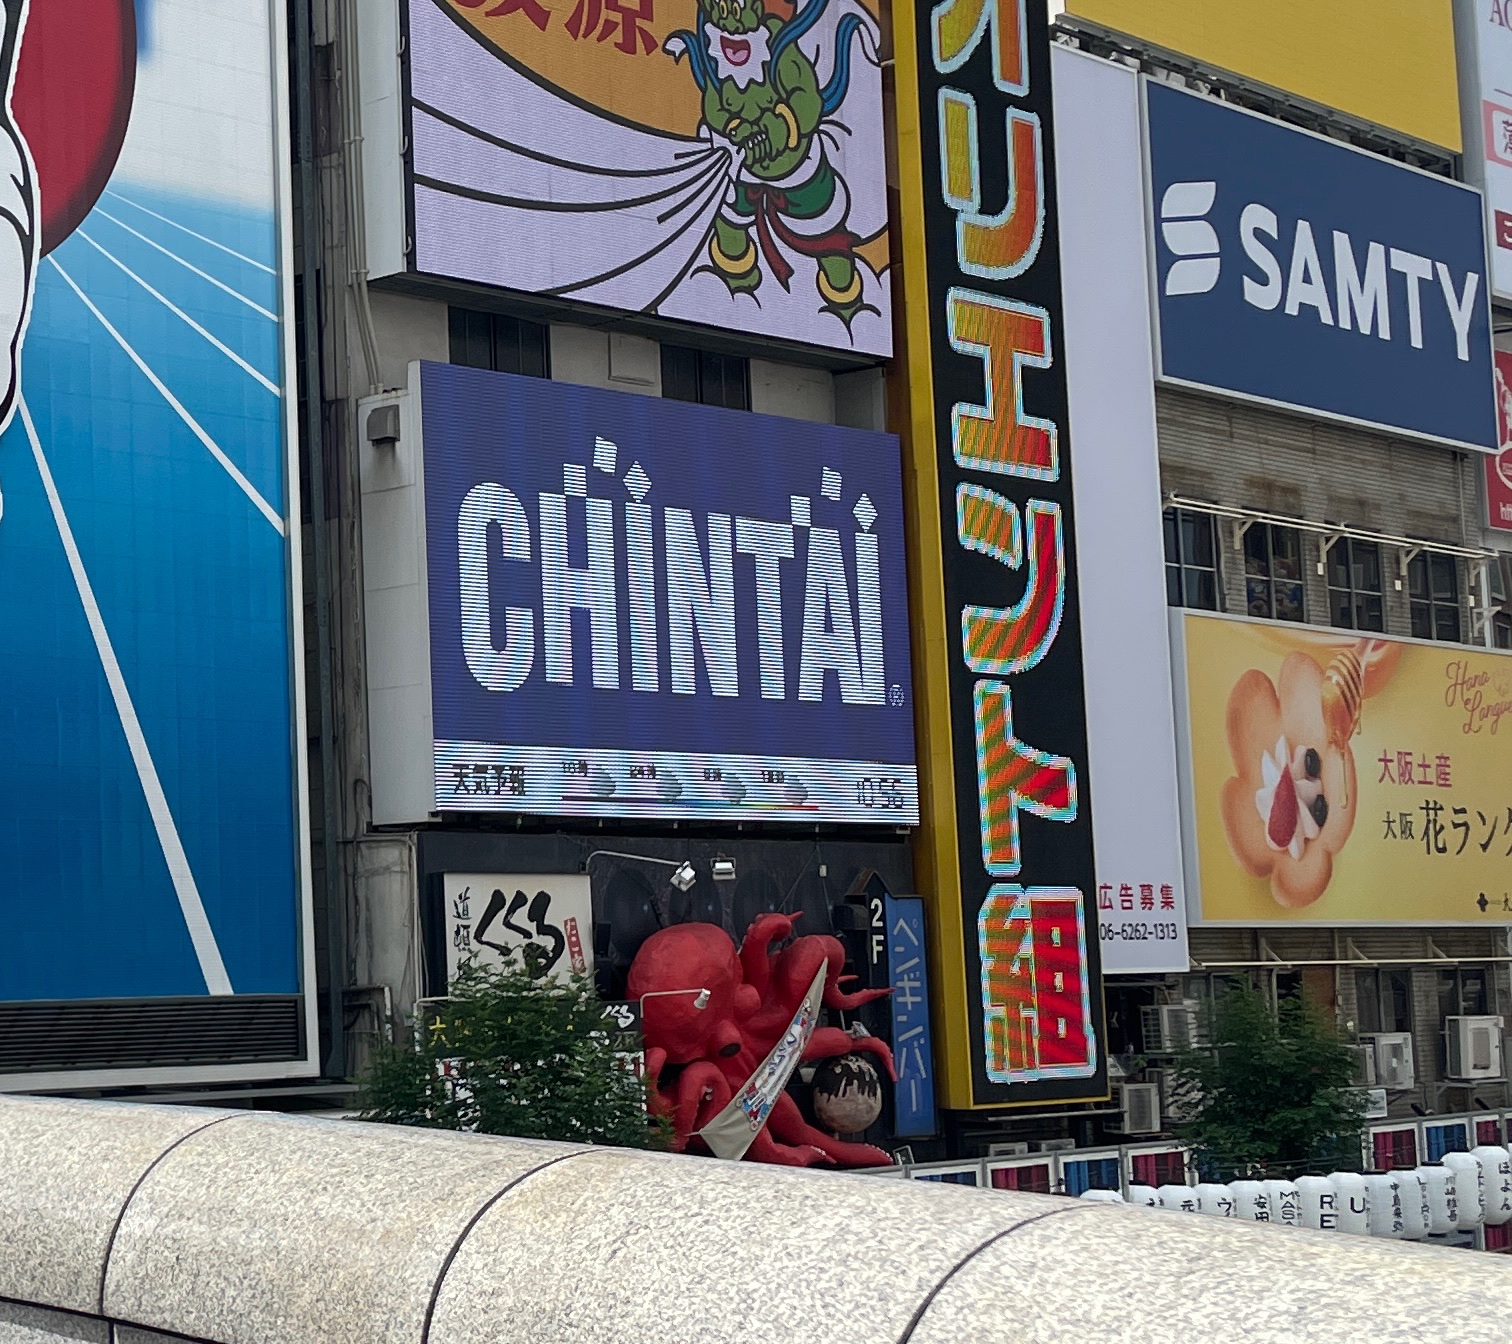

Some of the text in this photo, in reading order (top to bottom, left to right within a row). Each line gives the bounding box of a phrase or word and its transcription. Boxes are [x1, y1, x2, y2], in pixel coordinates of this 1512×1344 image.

[1239, 203, 1479, 361] SAMTY
[457, 436, 887, 706] CHINTAI
[1445, 660, 1490, 707] Hana
[1378, 749, 1453, 788] 大阪土産
[1381, 811, 1415, 841] 大阪
[1099, 883, 1176, 912] 広告募集
[1099, 923, 1178, 942] 06-6262-1313
[893, 916, 927, 1113] ペンギンバー
